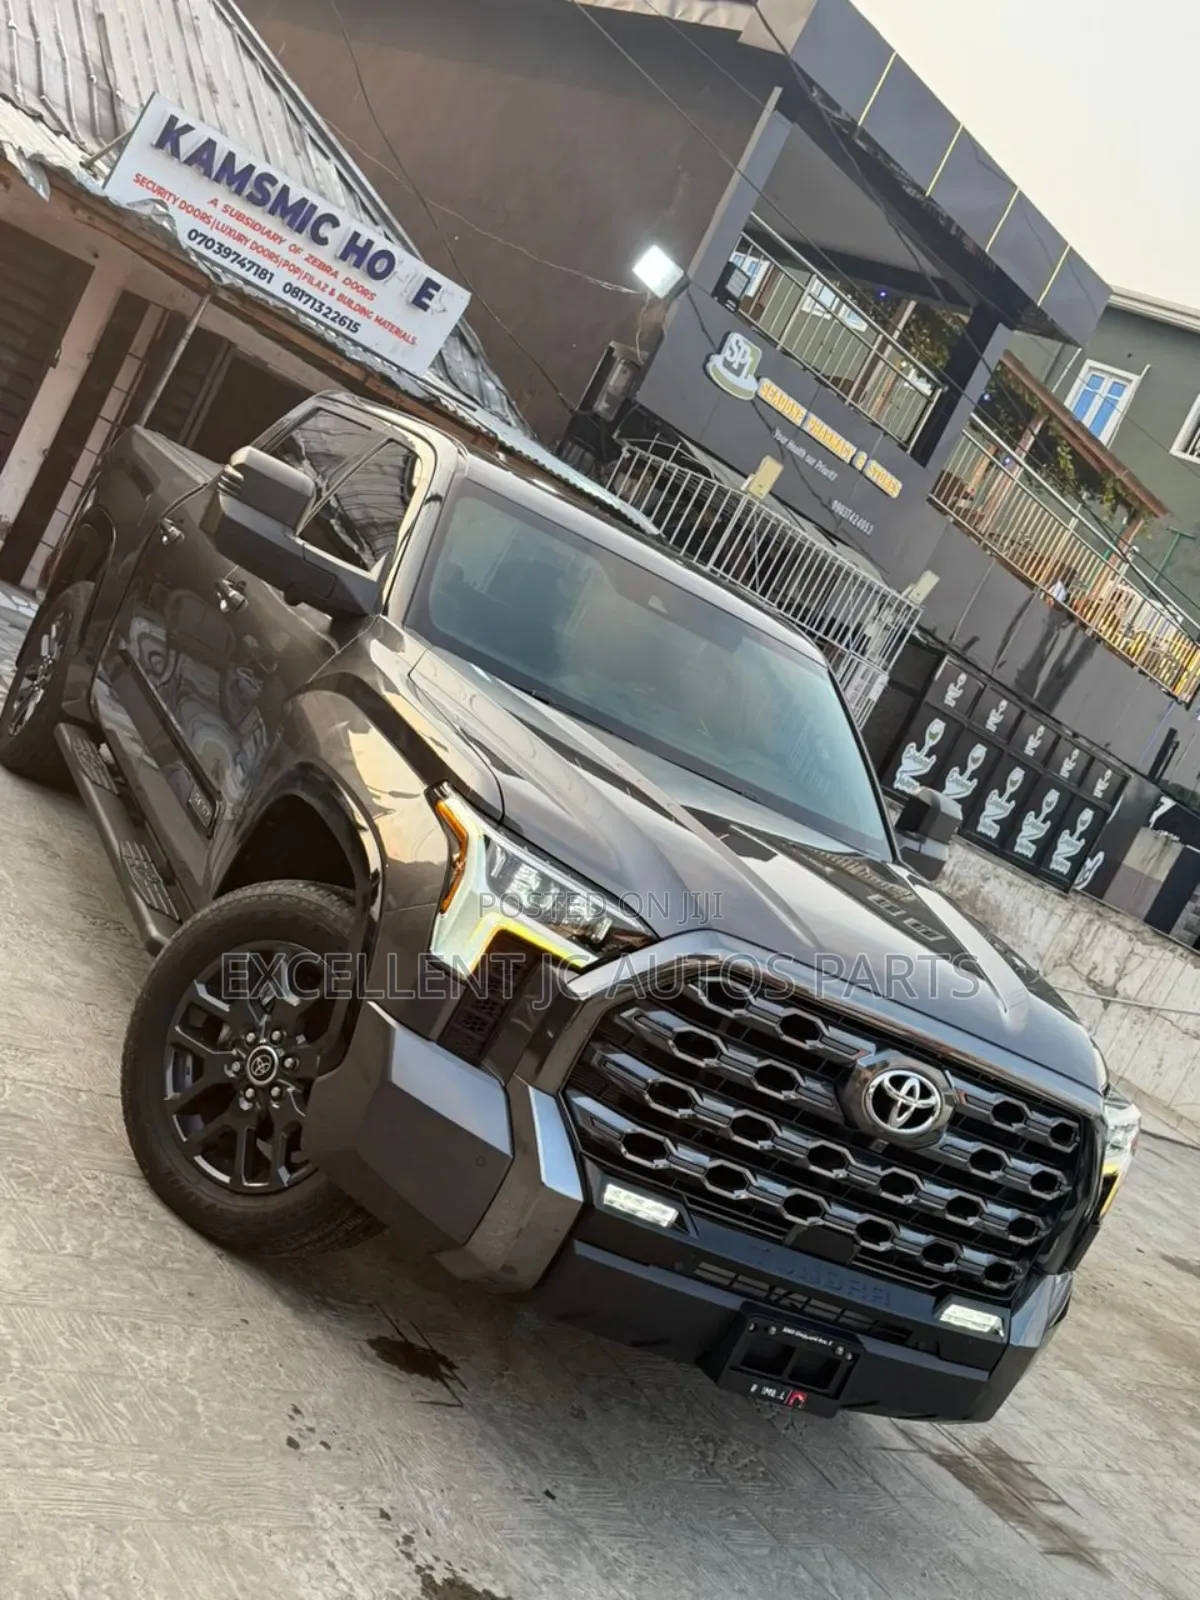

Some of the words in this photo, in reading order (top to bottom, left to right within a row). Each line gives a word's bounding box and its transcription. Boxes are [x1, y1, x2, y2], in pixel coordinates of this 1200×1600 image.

[132, 172, 180, 206] SECURITY
[327, 286, 337, 298] &
[336, 291, 375, 320] BUILDING
[373, 313, 418, 347] MATERIALS
[154, 113, 340, 247] KAMSMIC
[338, 230, 443, 313] HOE
[186, 227, 275, 286] 07039747181
[281, 280, 362, 335] 08171322615
[208, 197, 219, 208] A
[222, 203, 287, 246] SUBSIDIARY
[288, 243, 304, 256] OF
[303, 254, 339, 282] ZEBRA
[342, 276, 377, 303] DOORS
